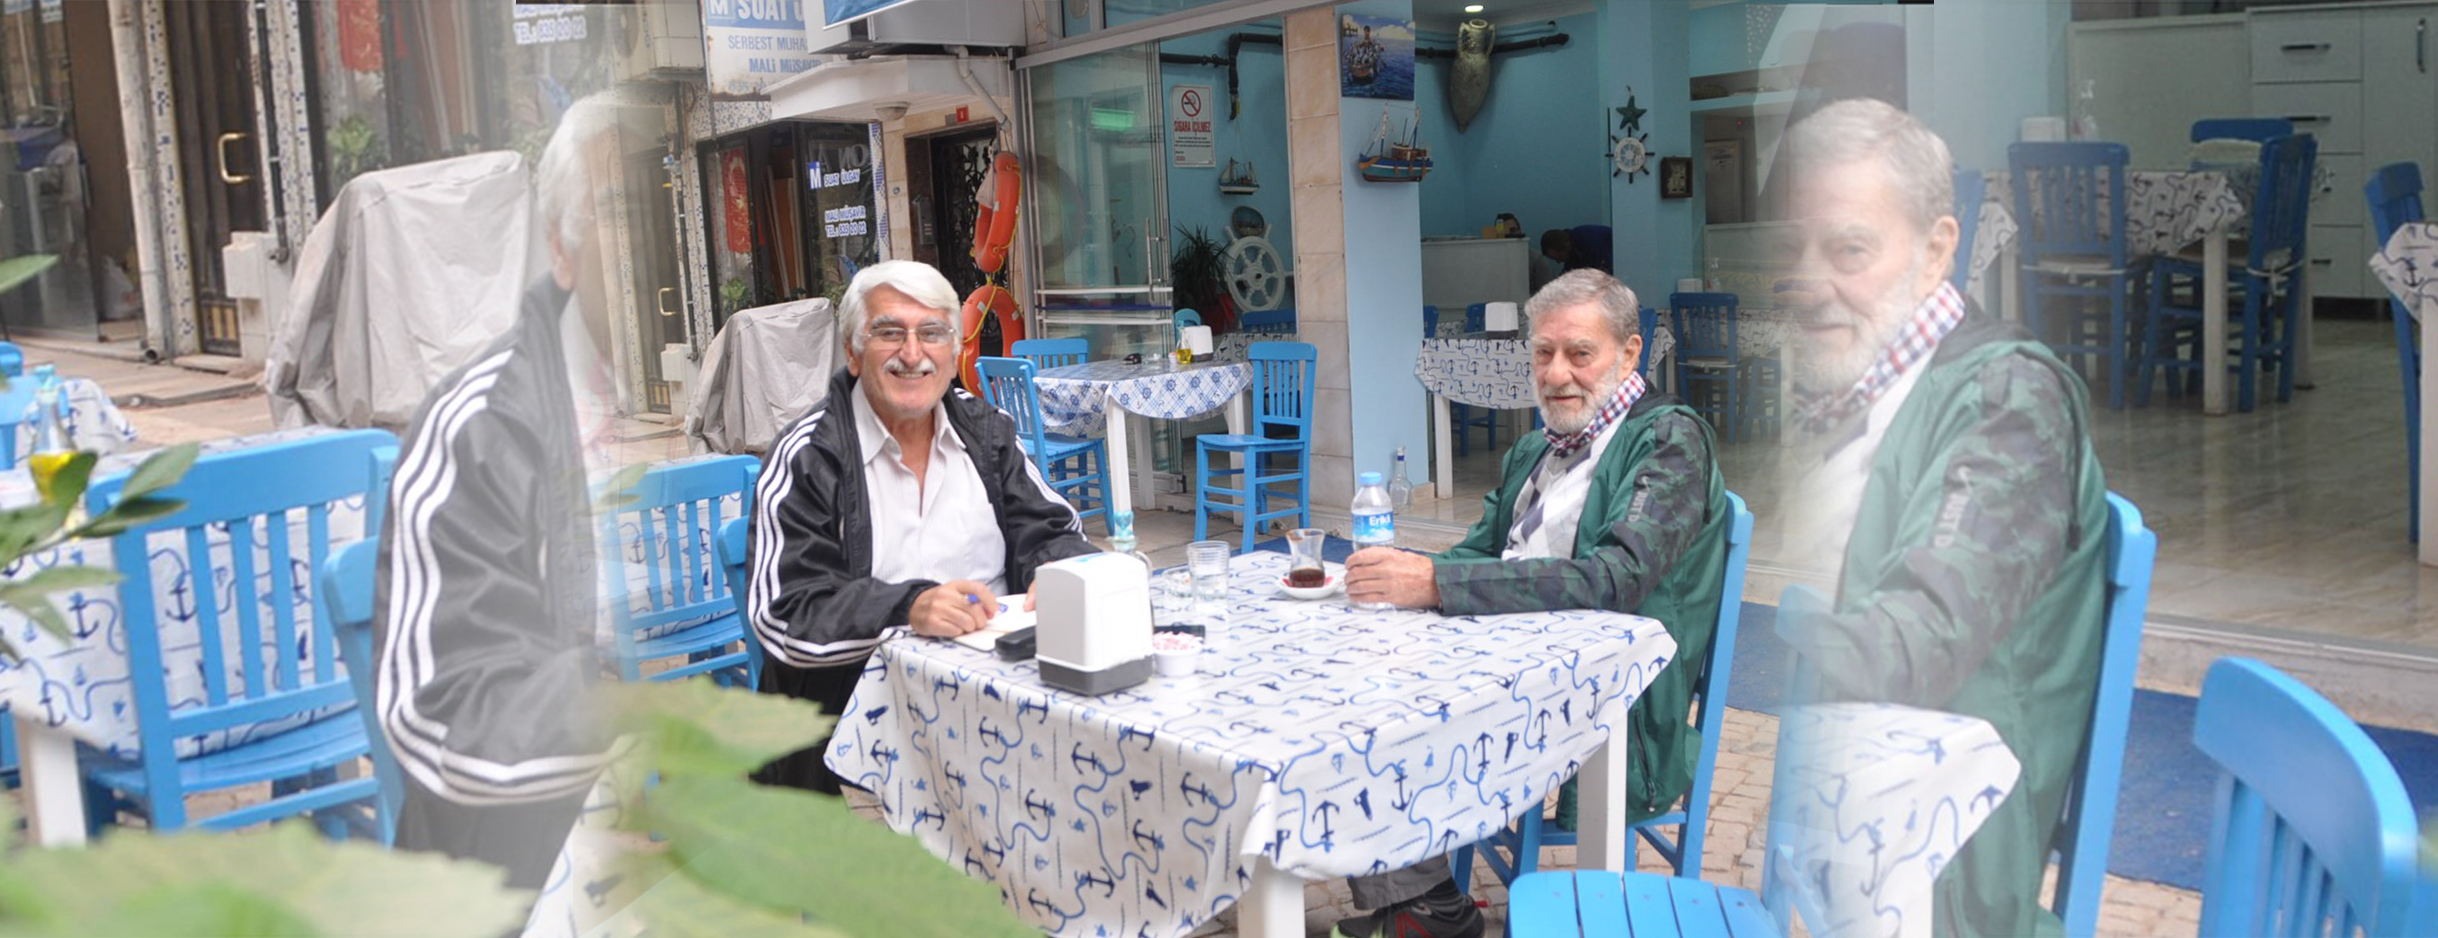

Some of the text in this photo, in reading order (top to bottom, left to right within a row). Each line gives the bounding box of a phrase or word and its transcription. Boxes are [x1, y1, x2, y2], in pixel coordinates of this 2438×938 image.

[738, 0, 787, 21] SUAT
[728, 35, 809, 51] SERBEST MUHA
